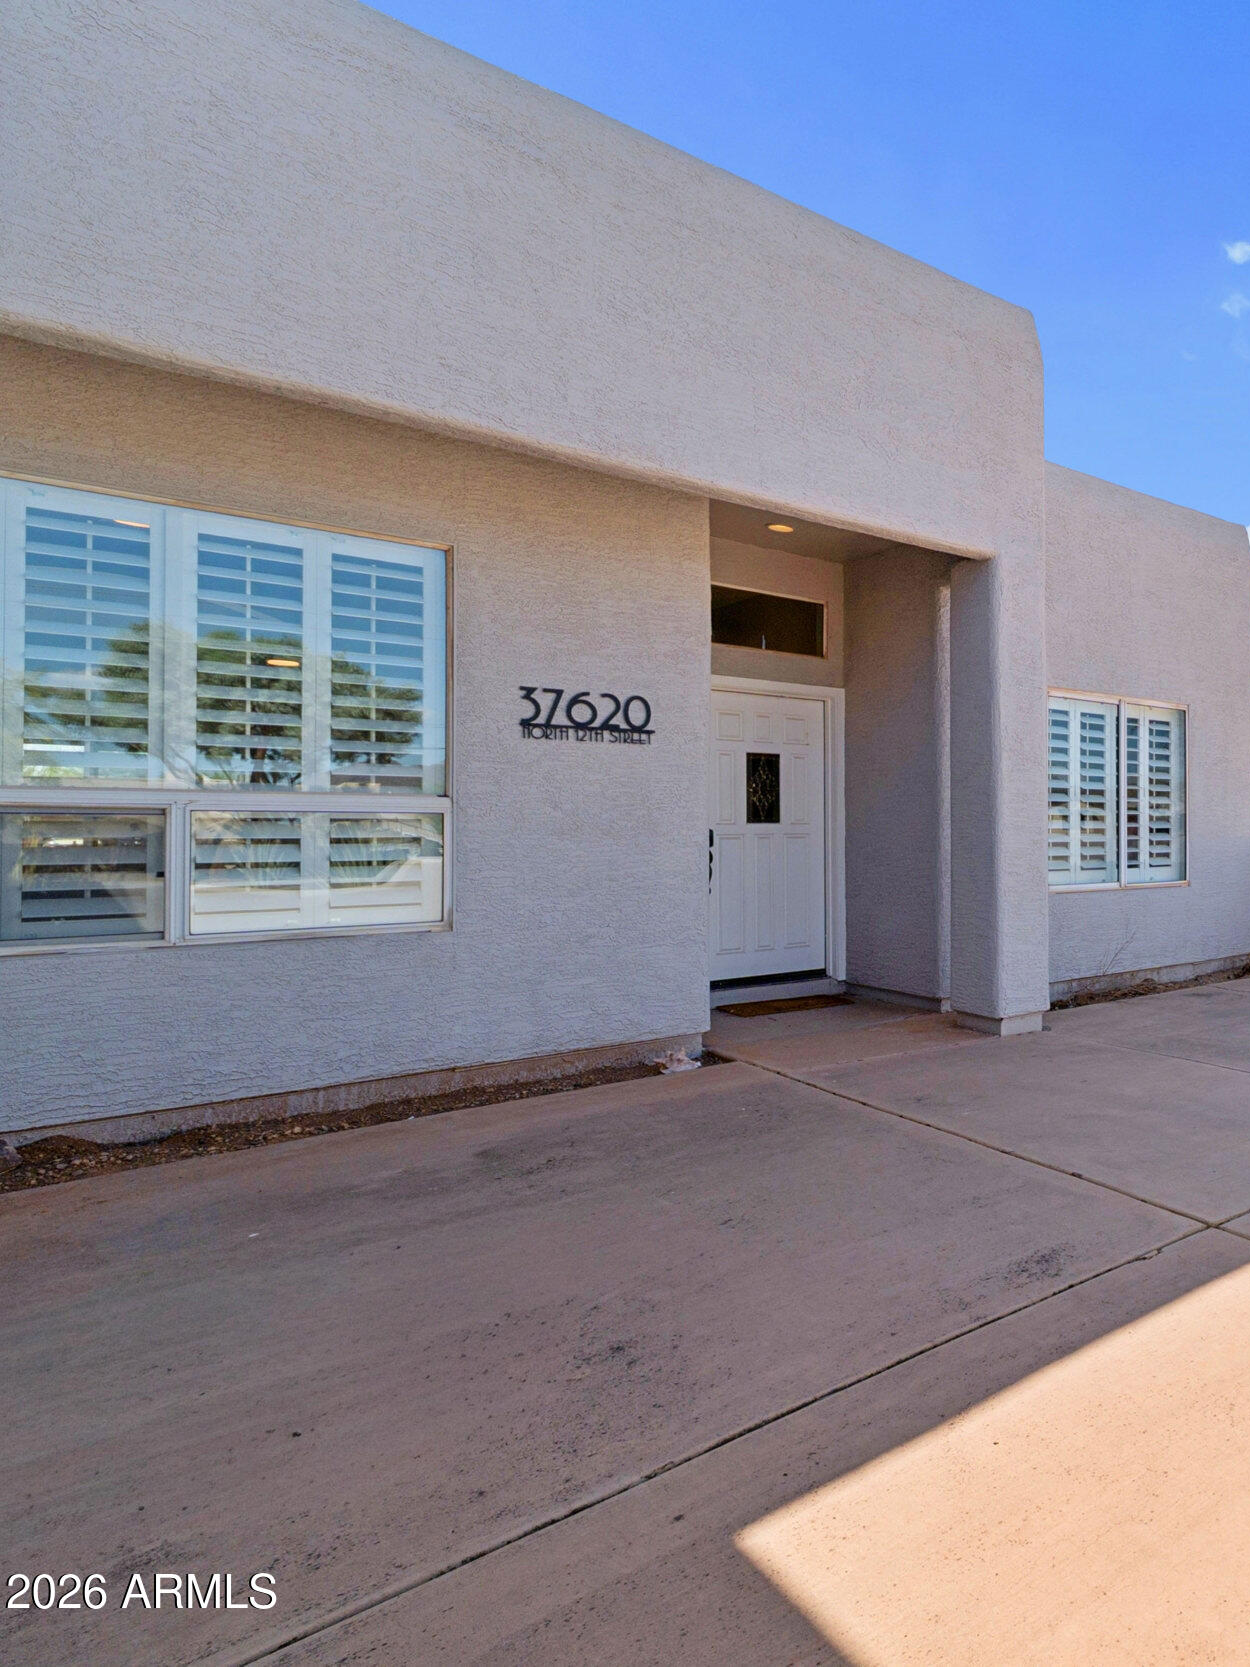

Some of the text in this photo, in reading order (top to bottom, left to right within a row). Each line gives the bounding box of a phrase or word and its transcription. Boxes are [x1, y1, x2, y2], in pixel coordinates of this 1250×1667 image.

[519, 686, 652, 731] 37620
[522, 725, 652, 745] NORTH 12TH STREET
